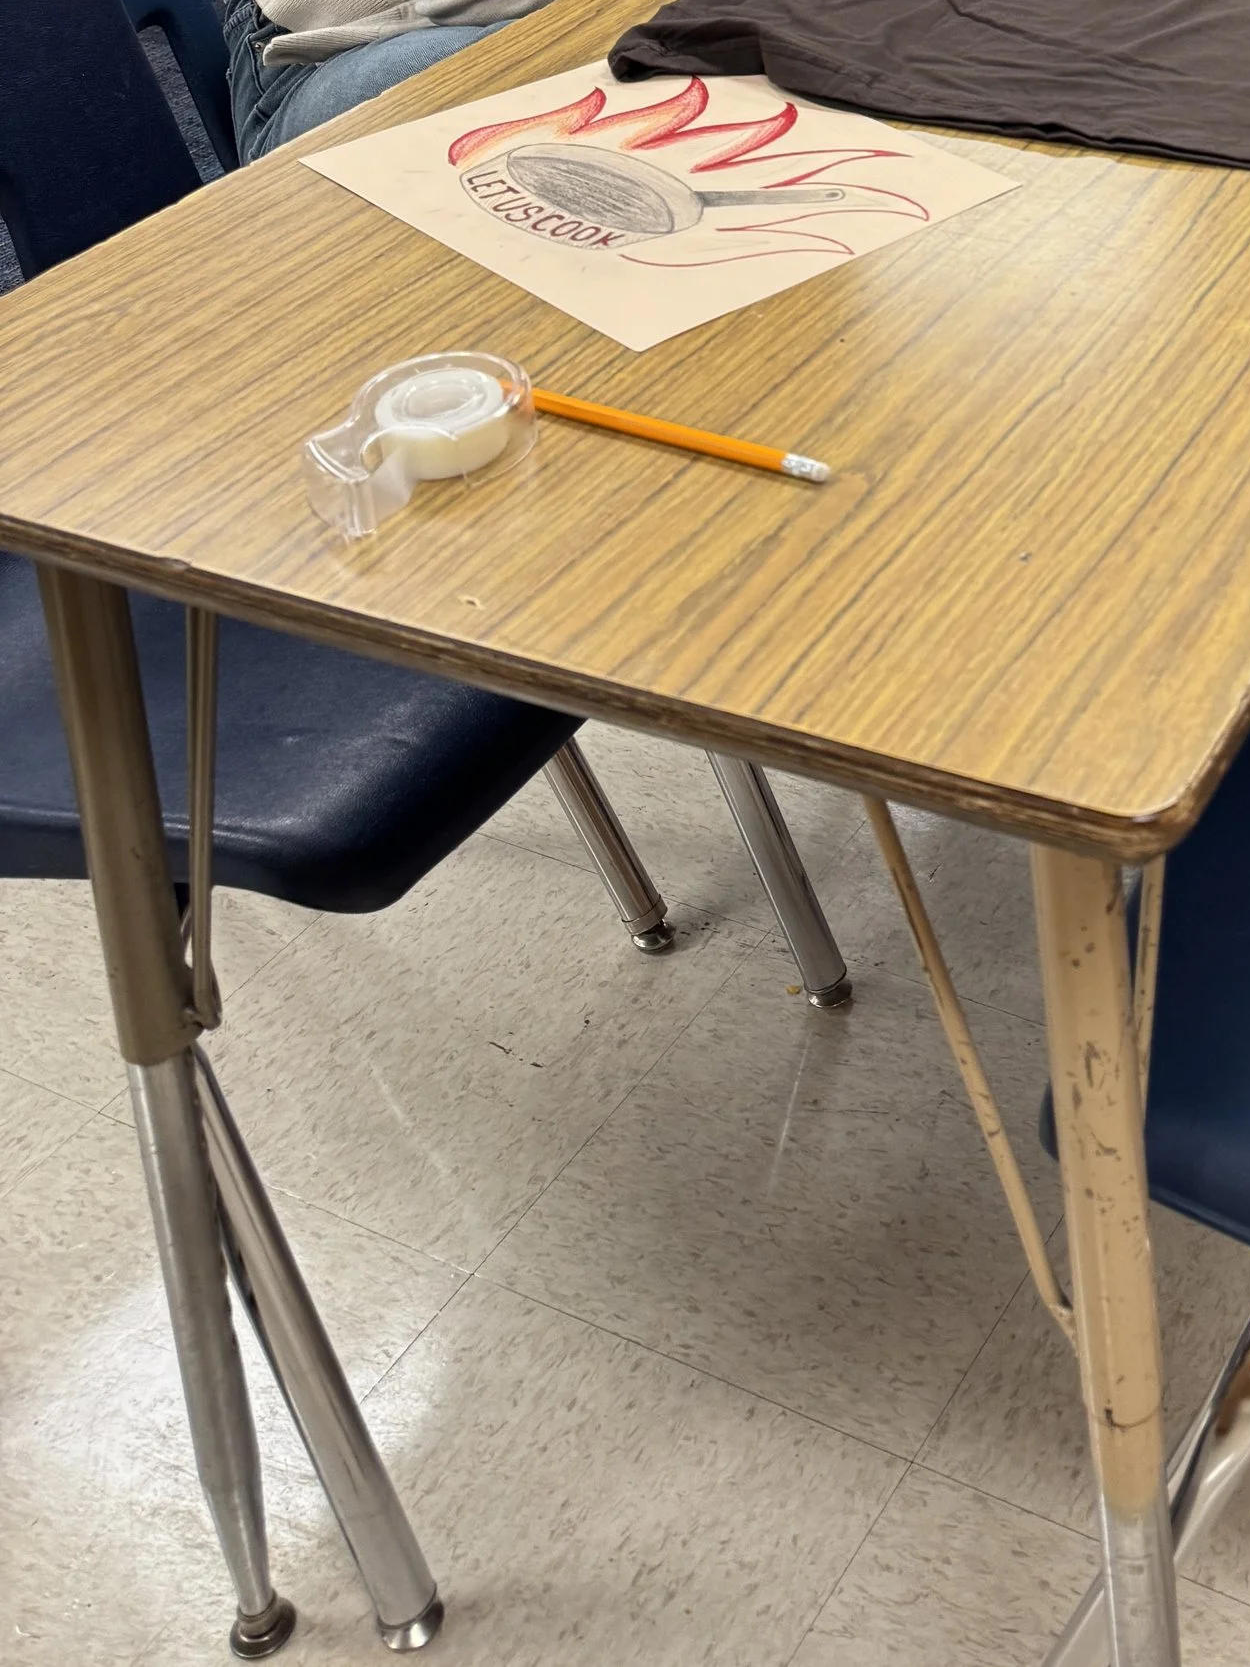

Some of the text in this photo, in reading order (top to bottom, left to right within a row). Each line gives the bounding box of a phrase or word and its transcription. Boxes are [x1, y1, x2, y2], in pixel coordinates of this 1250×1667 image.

[466, 170, 625, 247] LET US COOK
